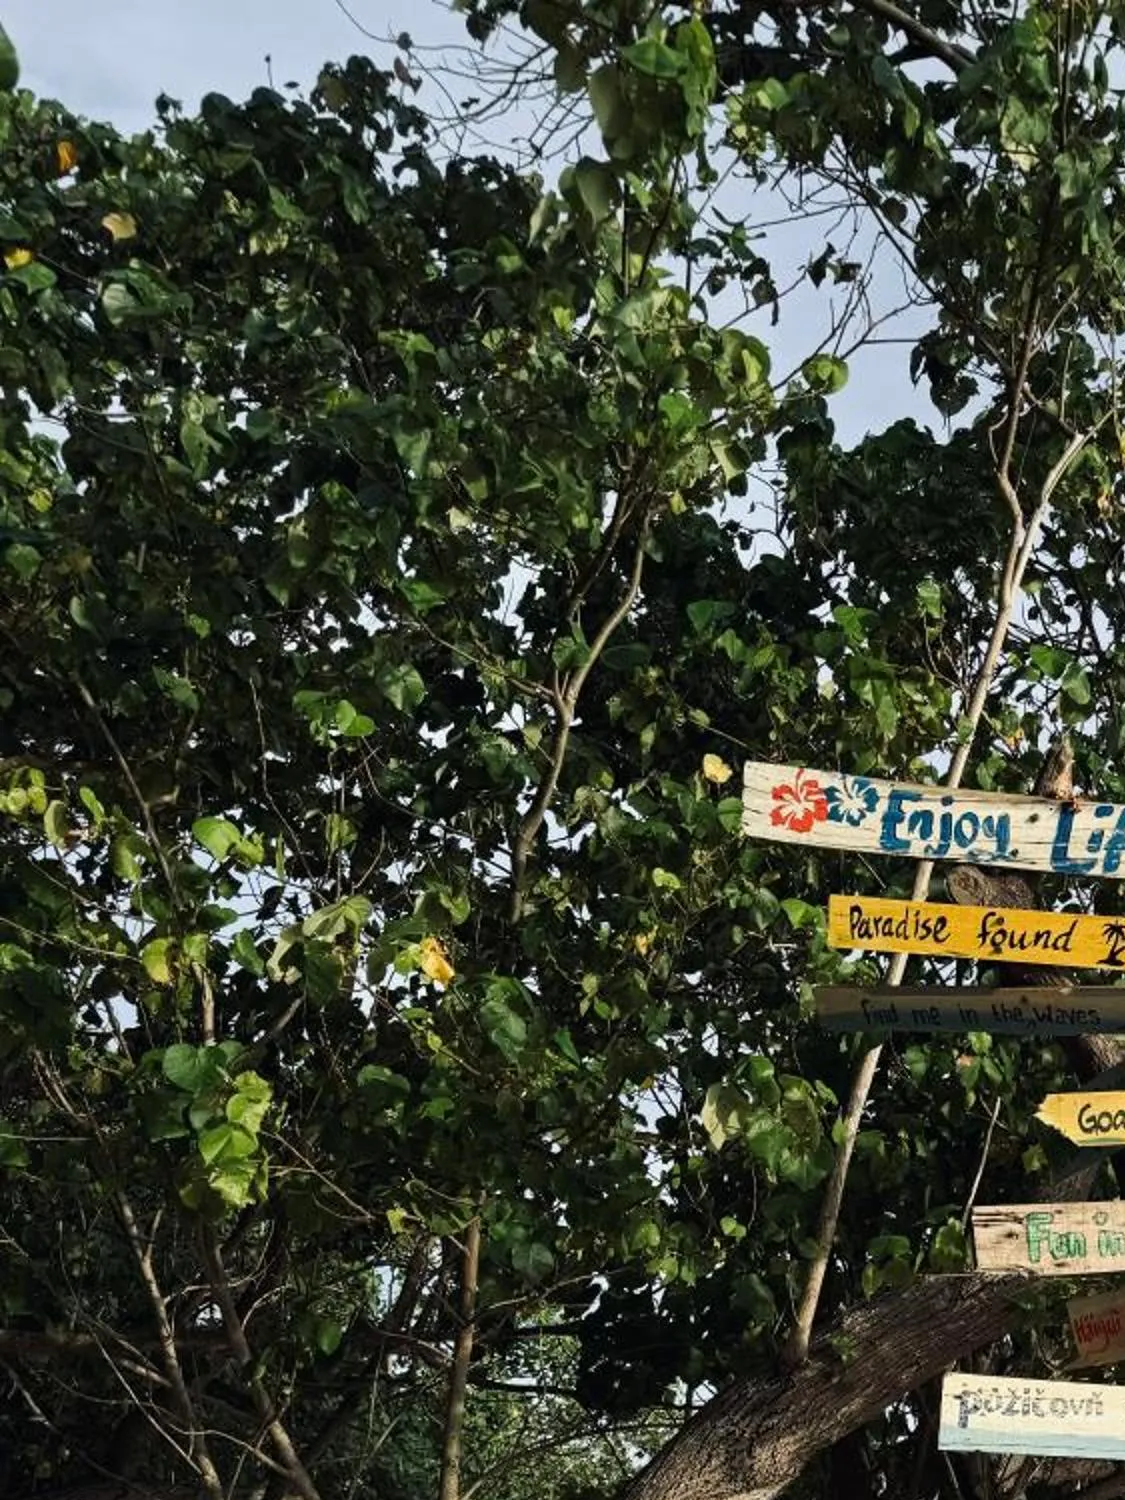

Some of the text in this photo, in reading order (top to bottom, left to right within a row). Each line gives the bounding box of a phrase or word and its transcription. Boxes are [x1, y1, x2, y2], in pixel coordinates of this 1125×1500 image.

[879, 789, 1019, 862] Enjoy
[850, 904, 1079, 953] Paradise found
[911, 1005, 943, 1026] me
[957, 1002, 980, 1026] in
[991, 1002, 1024, 1024] the
[1025, 1211, 1087, 1264] Fun
[1091, 1210, 1125, 1258] in
